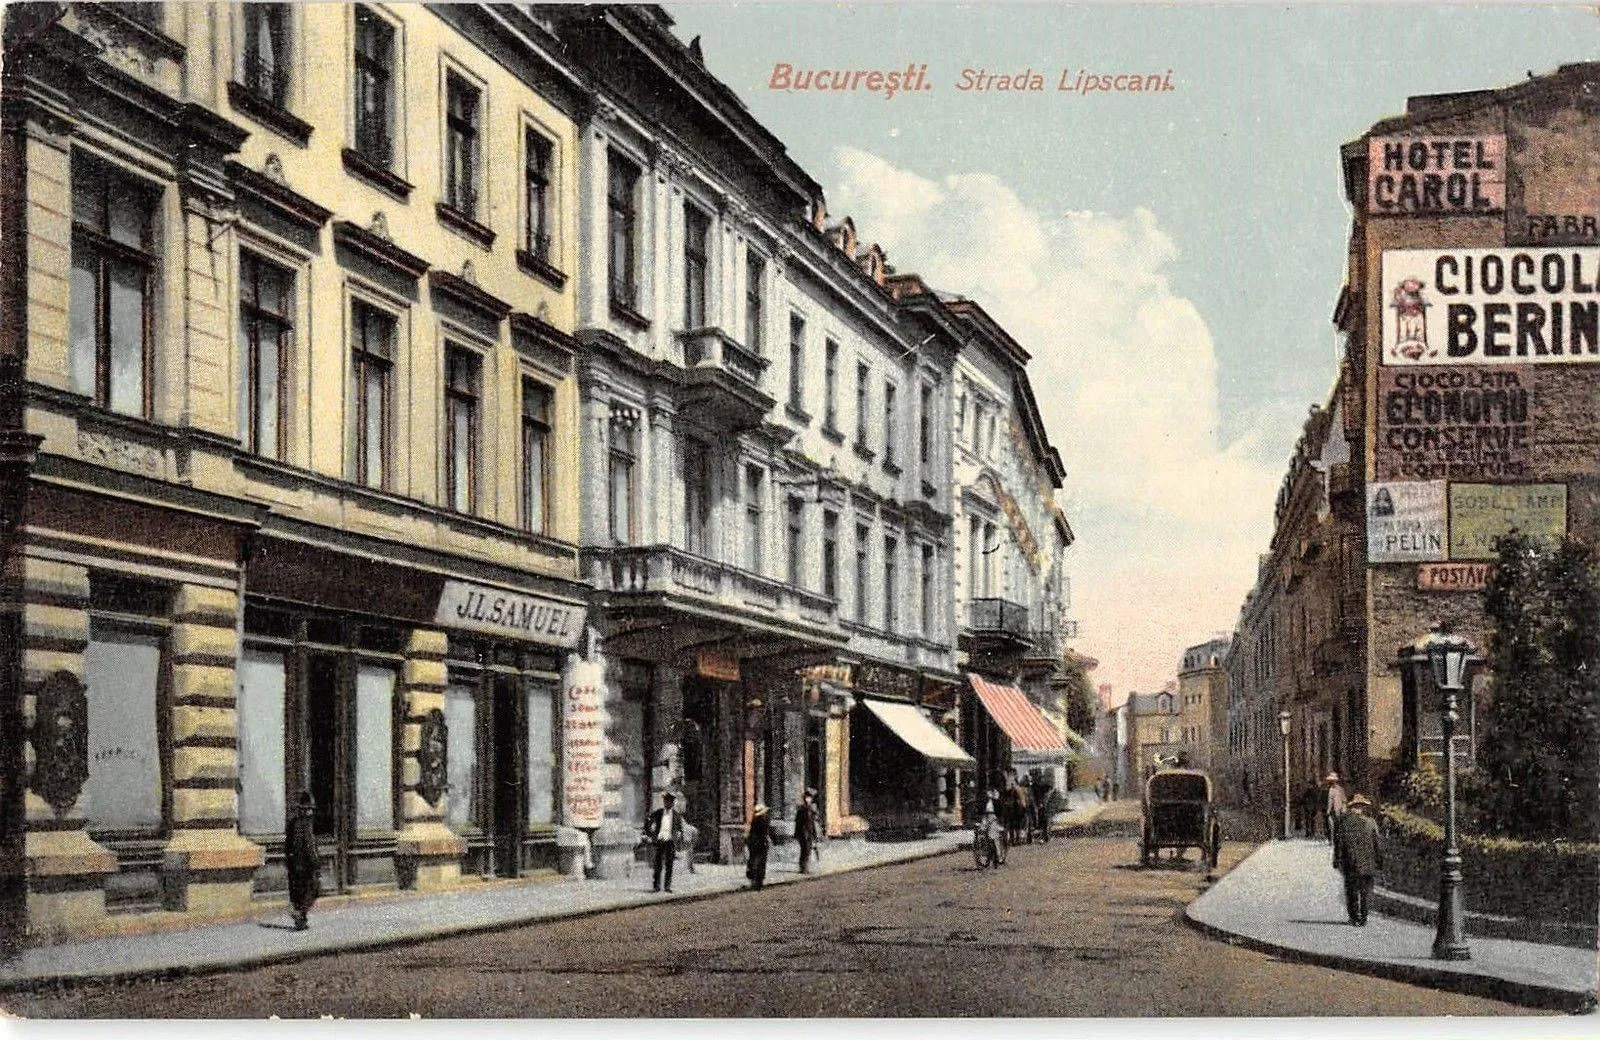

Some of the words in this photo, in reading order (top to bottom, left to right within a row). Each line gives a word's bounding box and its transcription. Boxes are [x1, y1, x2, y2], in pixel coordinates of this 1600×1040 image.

[1384, 141, 1495, 171] HOTEL
[1375, 172, 1490, 210] CAROL
[1448, 301, 1599, 358] BERIN
[1386, 534, 1441, 552] PELIN
